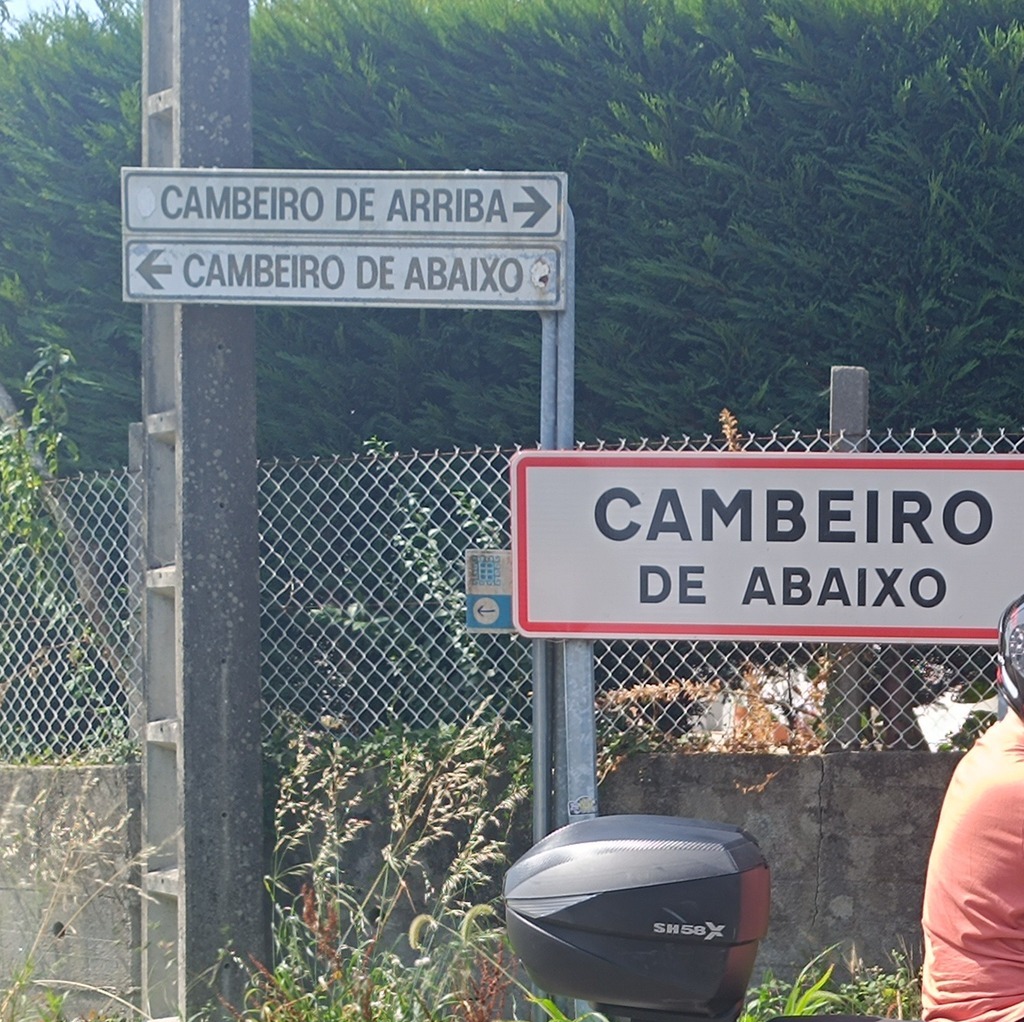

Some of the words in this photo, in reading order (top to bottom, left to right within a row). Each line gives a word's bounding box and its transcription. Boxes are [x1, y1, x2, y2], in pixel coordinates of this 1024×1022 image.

[161, 185, 324, 222] CAMBEIRO
[335, 187, 375, 222] DE
[387, 187, 508, 223] ARRIBA
[183, 253, 345, 290] CAMBEIRO
[356, 255, 395, 291] DE
[404, 257, 524, 293] ABAIXO
[594, 487, 994, 546] CAMBEIRO
[640, 565, 706, 604] DE
[742, 566, 947, 608] ABAIXO
[653, 921, 726, 941] SH58X
